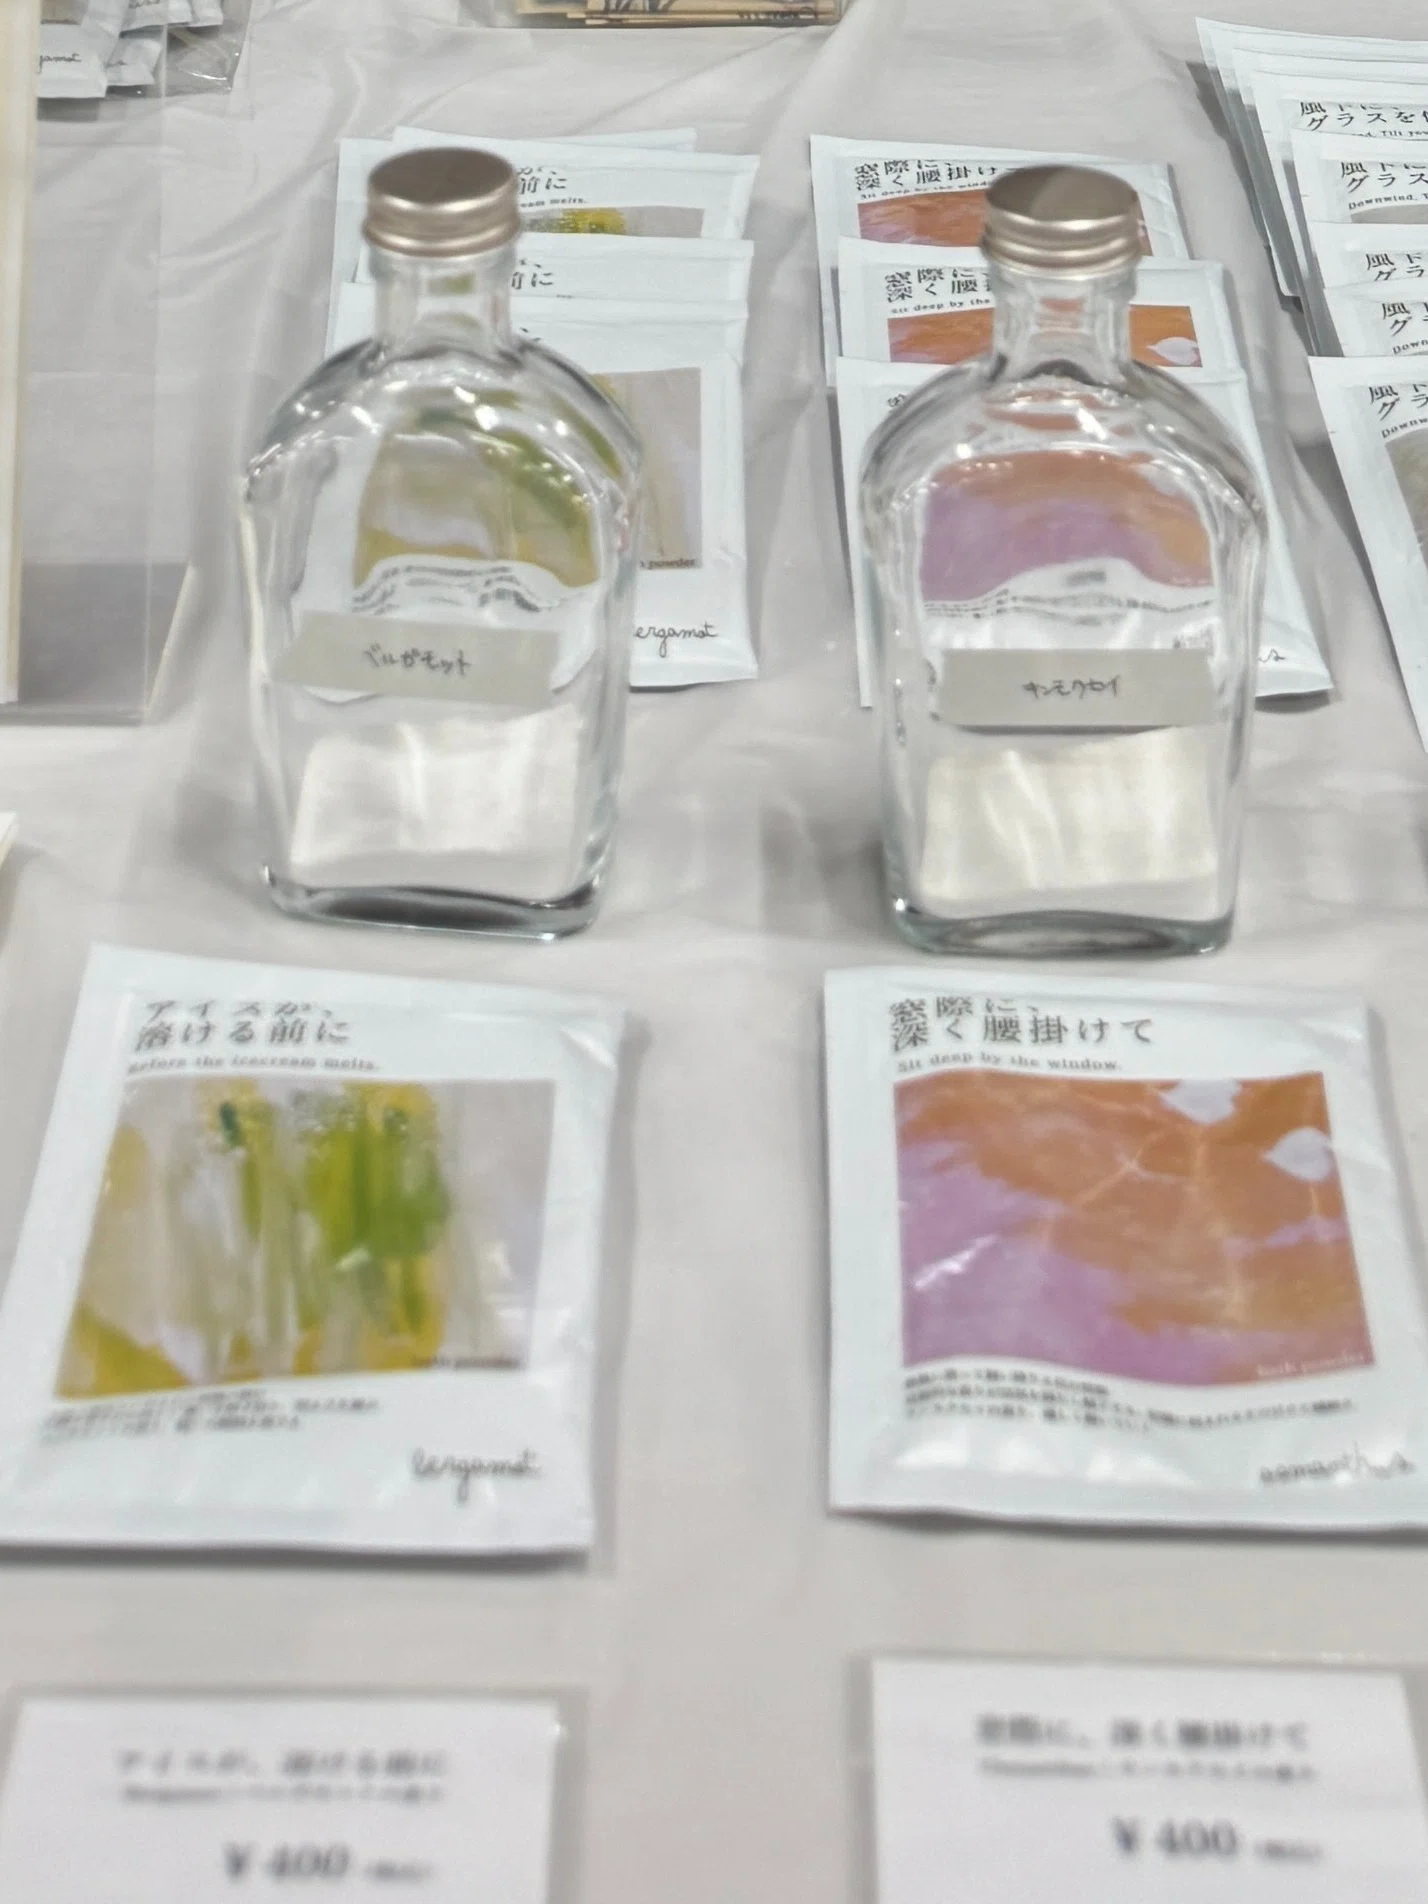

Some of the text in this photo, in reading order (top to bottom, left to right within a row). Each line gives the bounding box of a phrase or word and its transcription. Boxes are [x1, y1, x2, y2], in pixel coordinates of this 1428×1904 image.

[634, 621, 718, 658] ergamot
[1021, 674, 1121, 700] キンモクセイ
[889, 996, 1040, 1027] 窓際に、
[134, 1017, 351, 1053] 溶ける前に
[891, 1015, 1154, 1053] 深く腰掛けて
